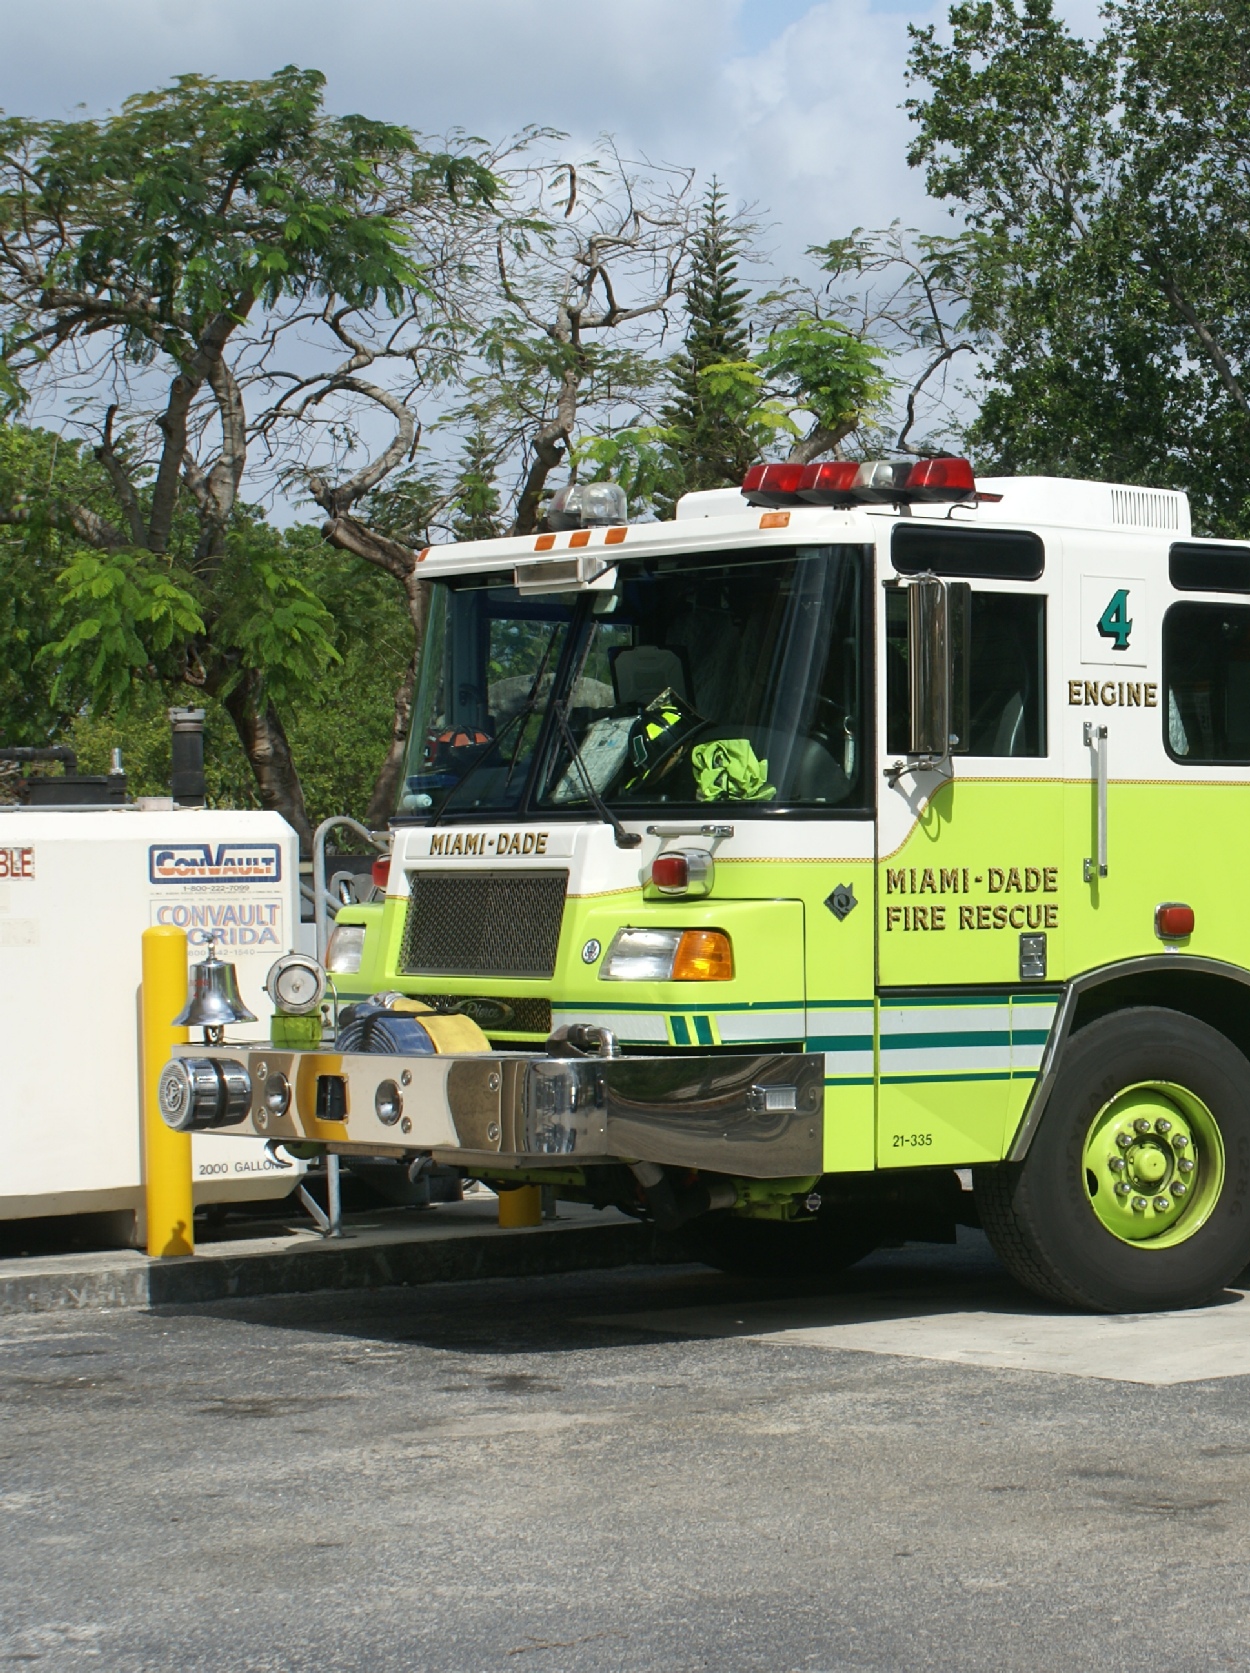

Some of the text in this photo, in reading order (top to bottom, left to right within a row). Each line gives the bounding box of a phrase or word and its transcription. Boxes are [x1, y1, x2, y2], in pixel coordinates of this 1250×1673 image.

[1096, 588, 1133, 651] 4
[1068, 680, 1158, 707] ENGINE
[156, 904, 280, 927] CONVAULT
[886, 904, 1058, 931] FIRE RESCUE
[187, 927, 280, 946] ORIDA
[893, 1134, 932, 1147] 21-335
[199, 1160, 285, 1175] 2000 GALLO
